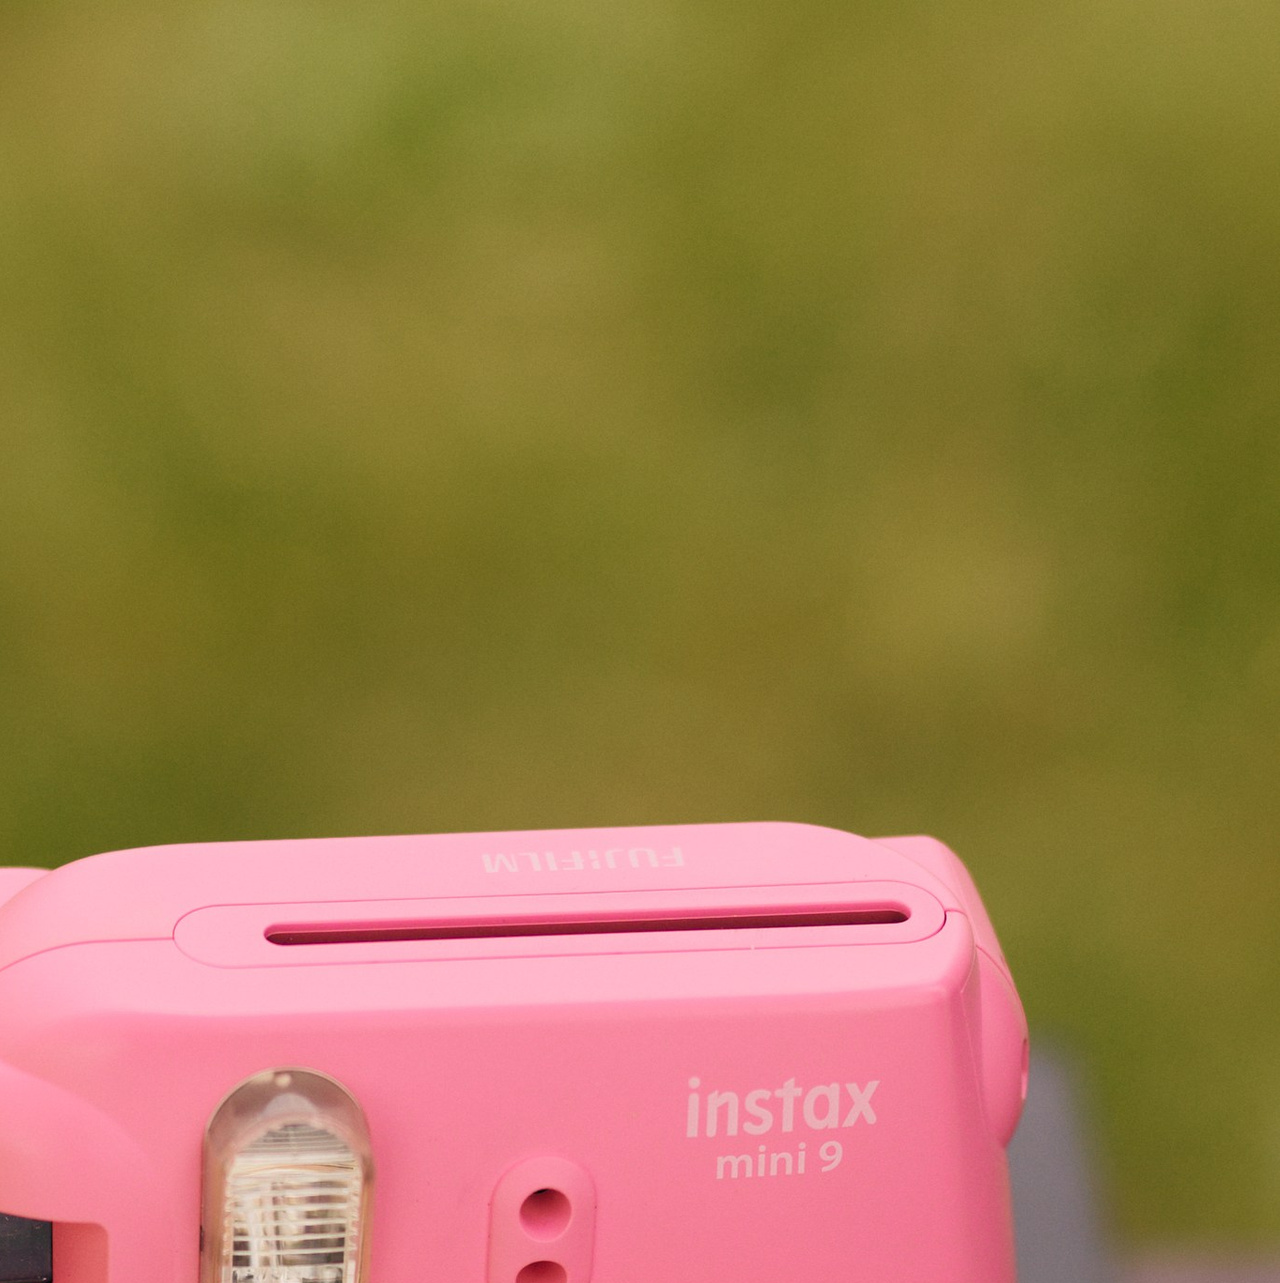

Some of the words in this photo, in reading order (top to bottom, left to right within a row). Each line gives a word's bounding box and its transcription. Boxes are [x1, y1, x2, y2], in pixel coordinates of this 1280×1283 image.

[481, 847, 685, 873] FUJIFILM
[686, 1076, 881, 1138] instax
[716, 1142, 807, 1180] mini
[818, 1140, 844, 1174] 9
